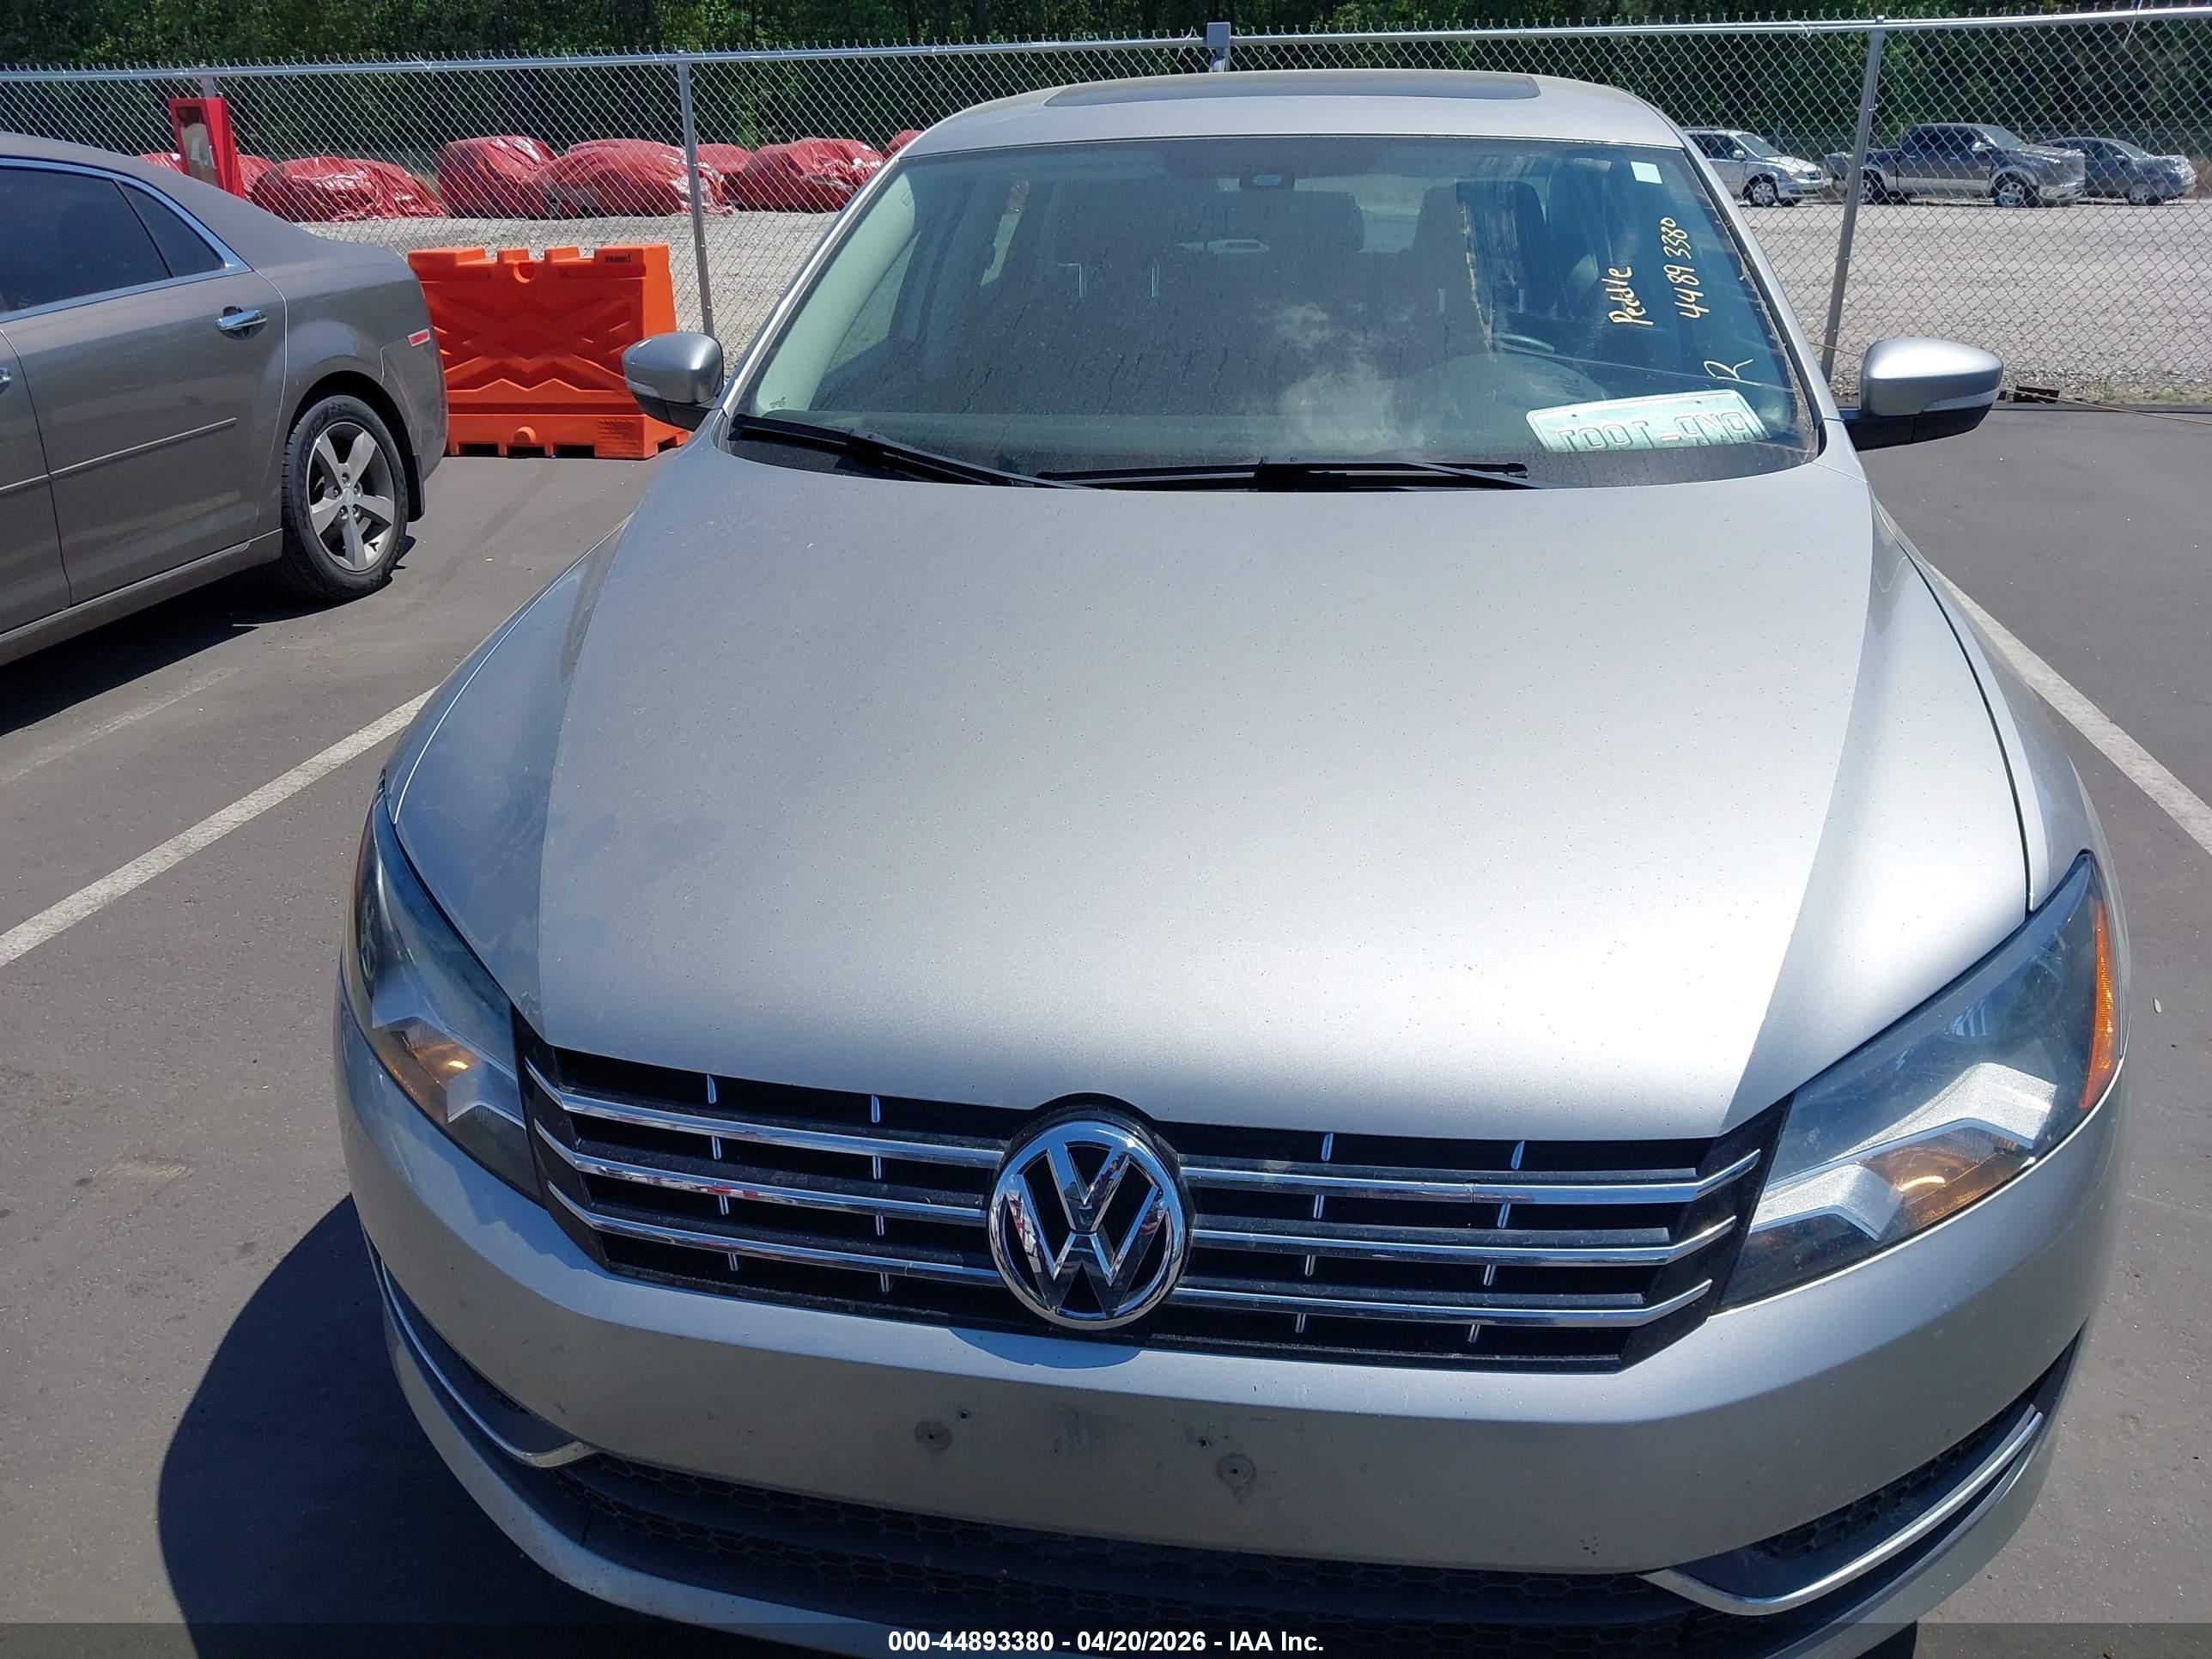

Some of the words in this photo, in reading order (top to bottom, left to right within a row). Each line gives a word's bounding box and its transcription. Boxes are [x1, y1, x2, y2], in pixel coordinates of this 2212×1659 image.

[1660, 216, 1692, 259] 3380
[1601, 266, 1654, 325] Peddle
[1663, 264, 1711, 319] 4489
[994, 1128, 1176, 1321] VW
